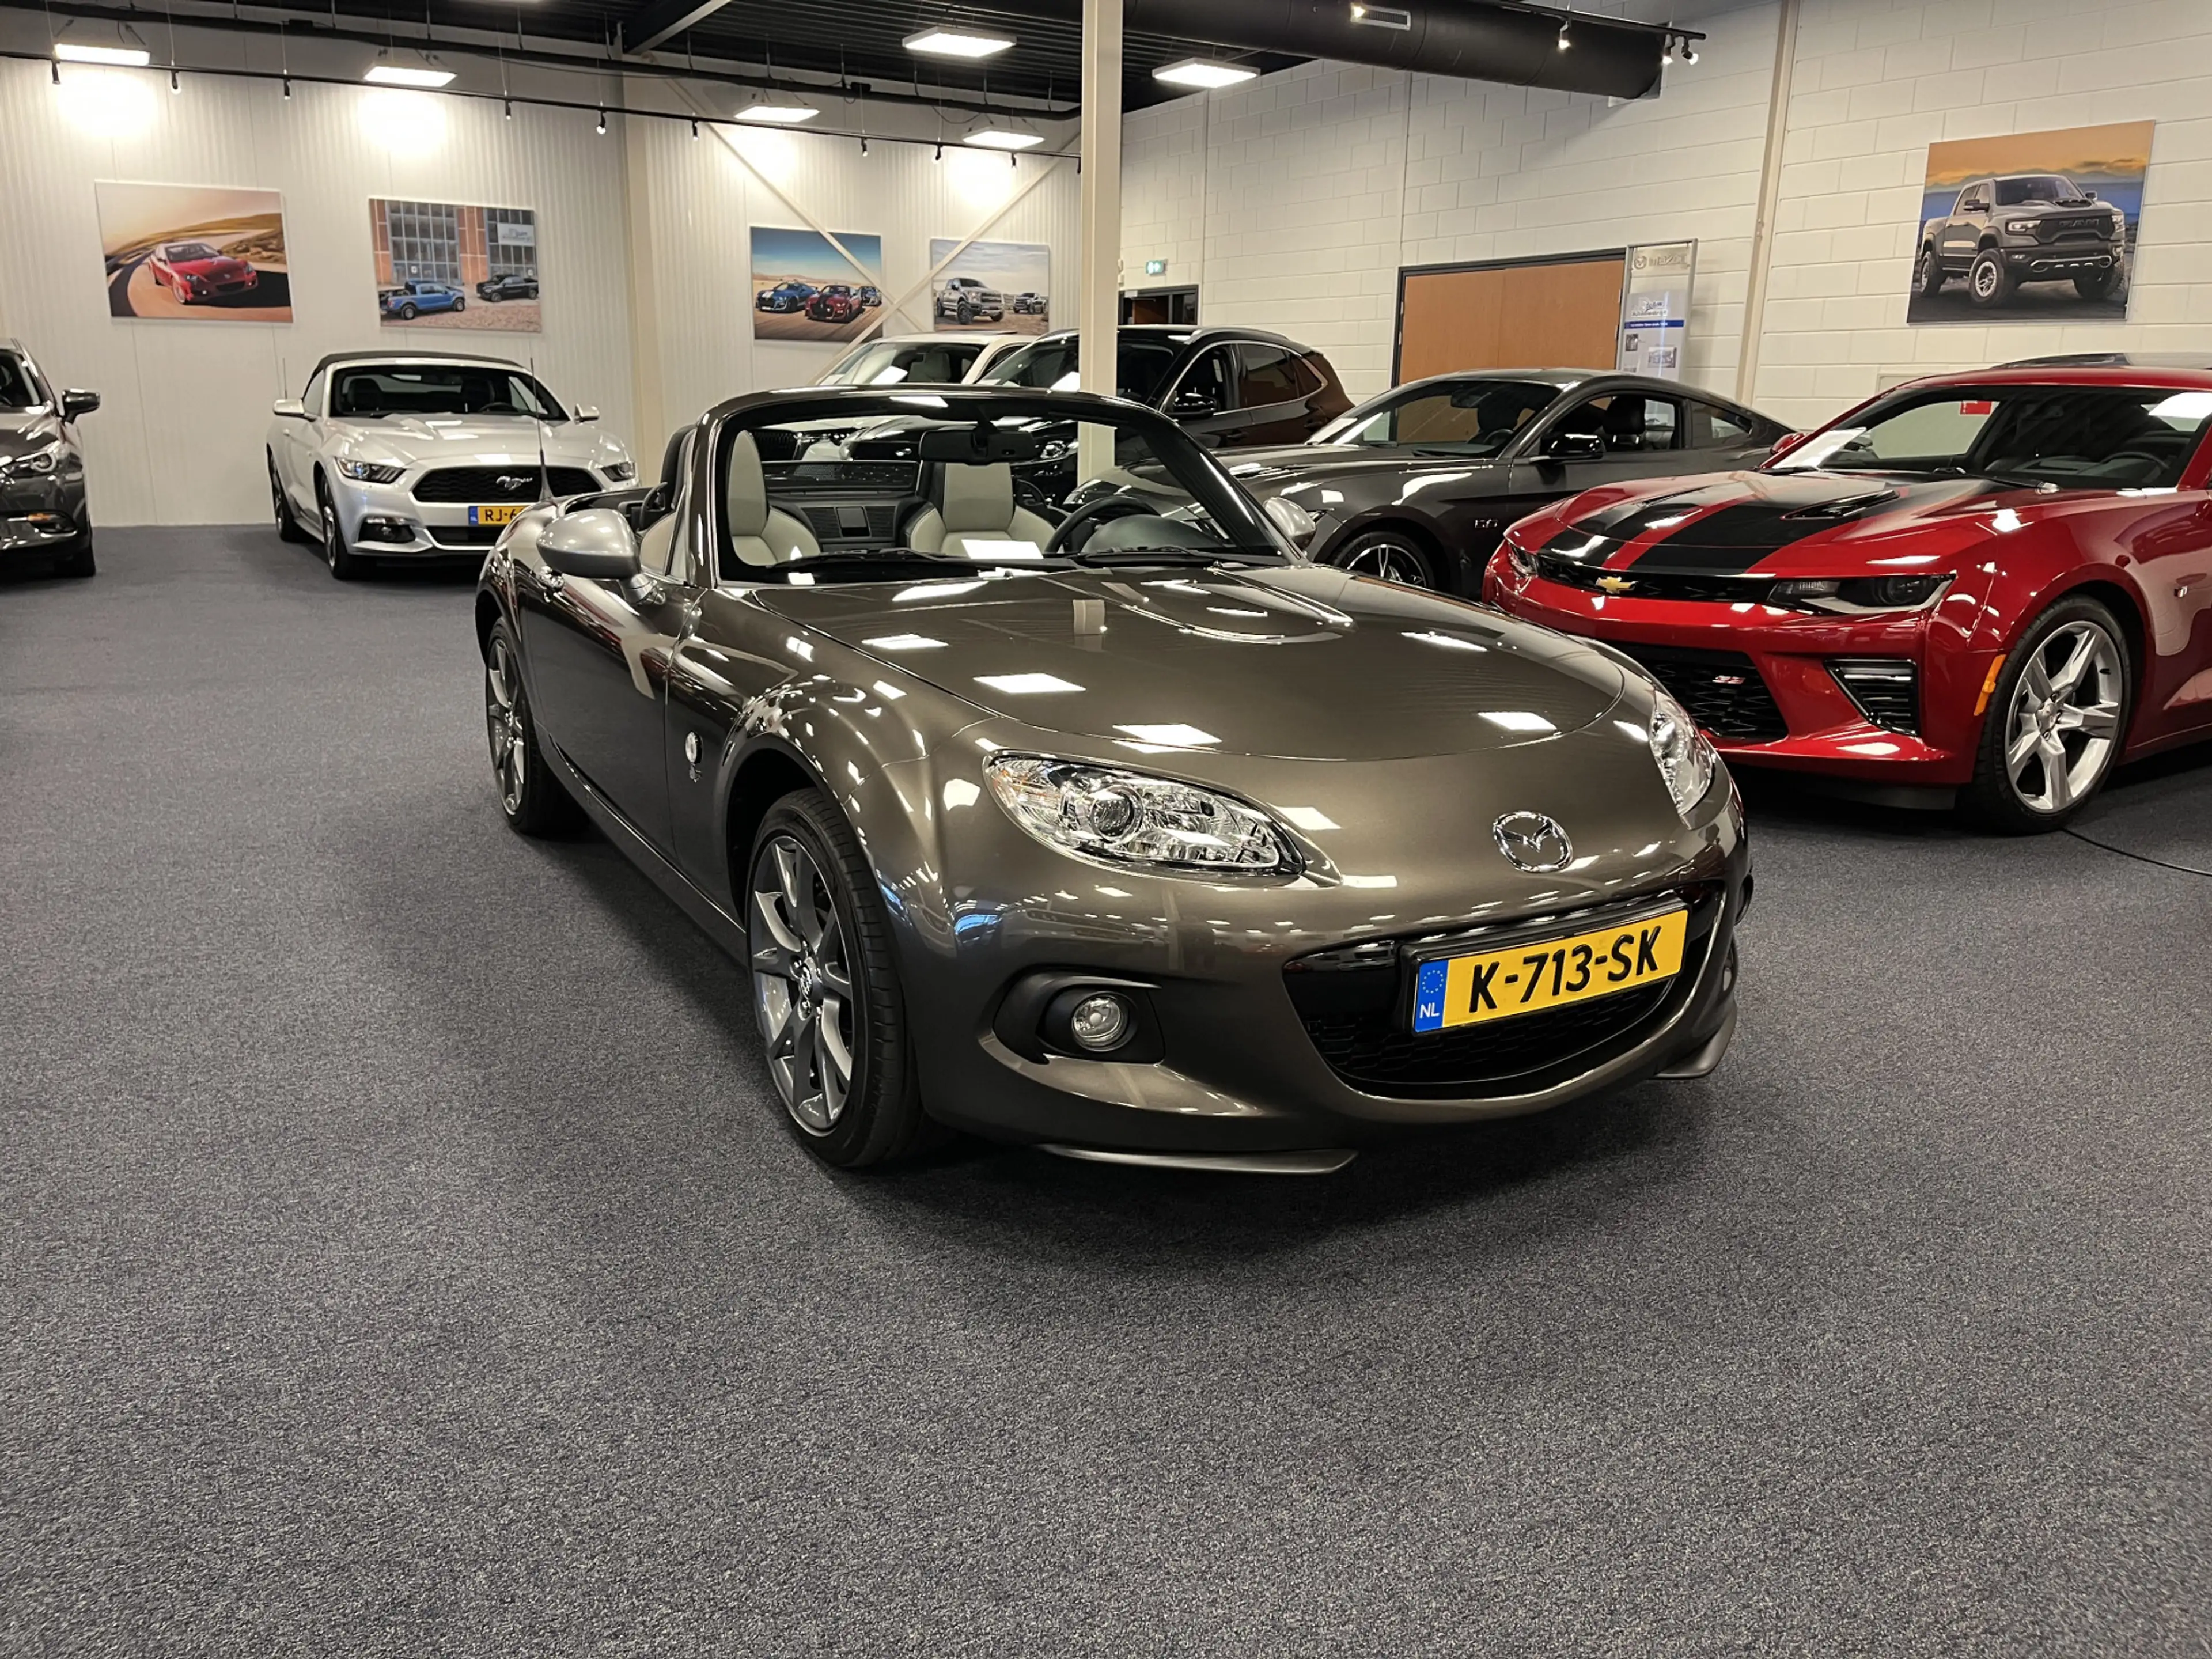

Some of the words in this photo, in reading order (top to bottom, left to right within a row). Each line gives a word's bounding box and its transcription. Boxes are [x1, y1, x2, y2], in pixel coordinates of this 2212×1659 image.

[485, 508, 524, 521] RJ-6
[1469, 926, 1662, 1013] K-713-SK
[1419, 1003, 1440, 1019] NL
